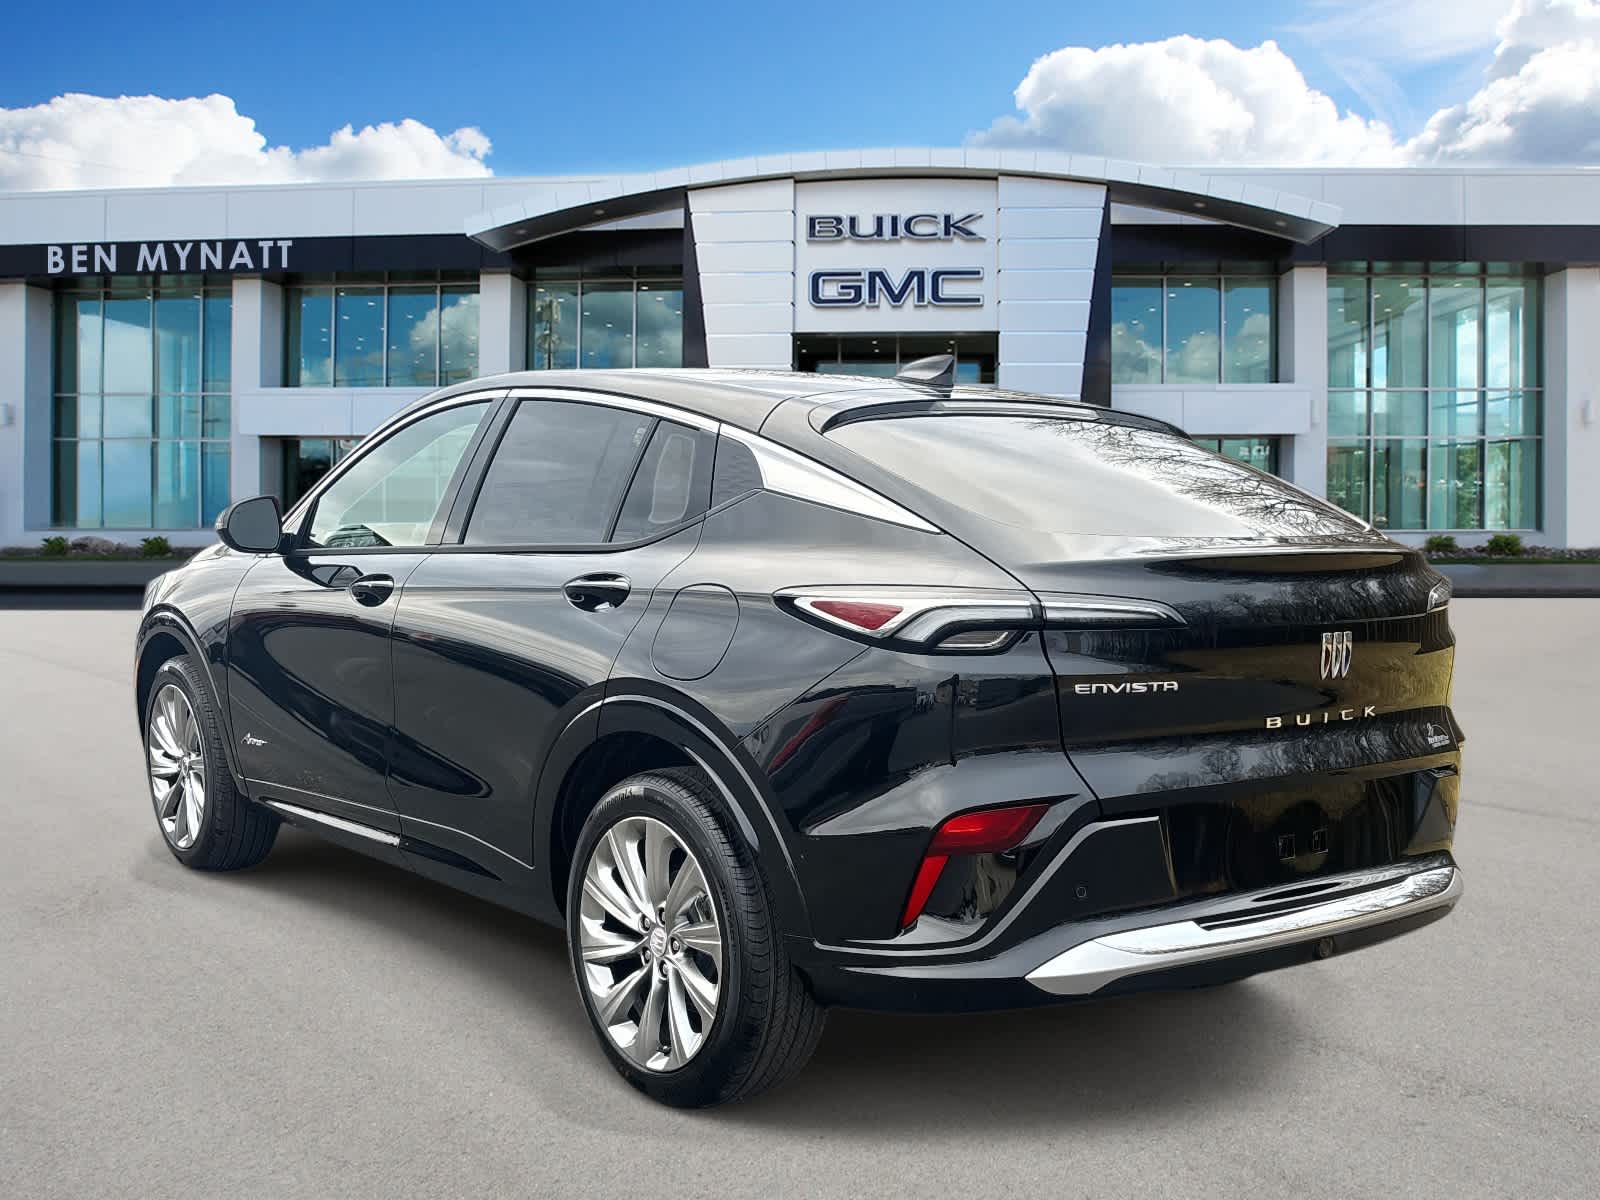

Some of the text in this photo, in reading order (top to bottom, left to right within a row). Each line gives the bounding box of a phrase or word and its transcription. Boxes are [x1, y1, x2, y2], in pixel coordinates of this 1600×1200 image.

[807, 213, 985, 242] BUICK
[47, 240, 293, 274] BEN MYNATT
[809, 267, 984, 308] GMC
[1074, 681, 1179, 695] ENVISTA
[1266, 704, 1377, 729] BUICK
